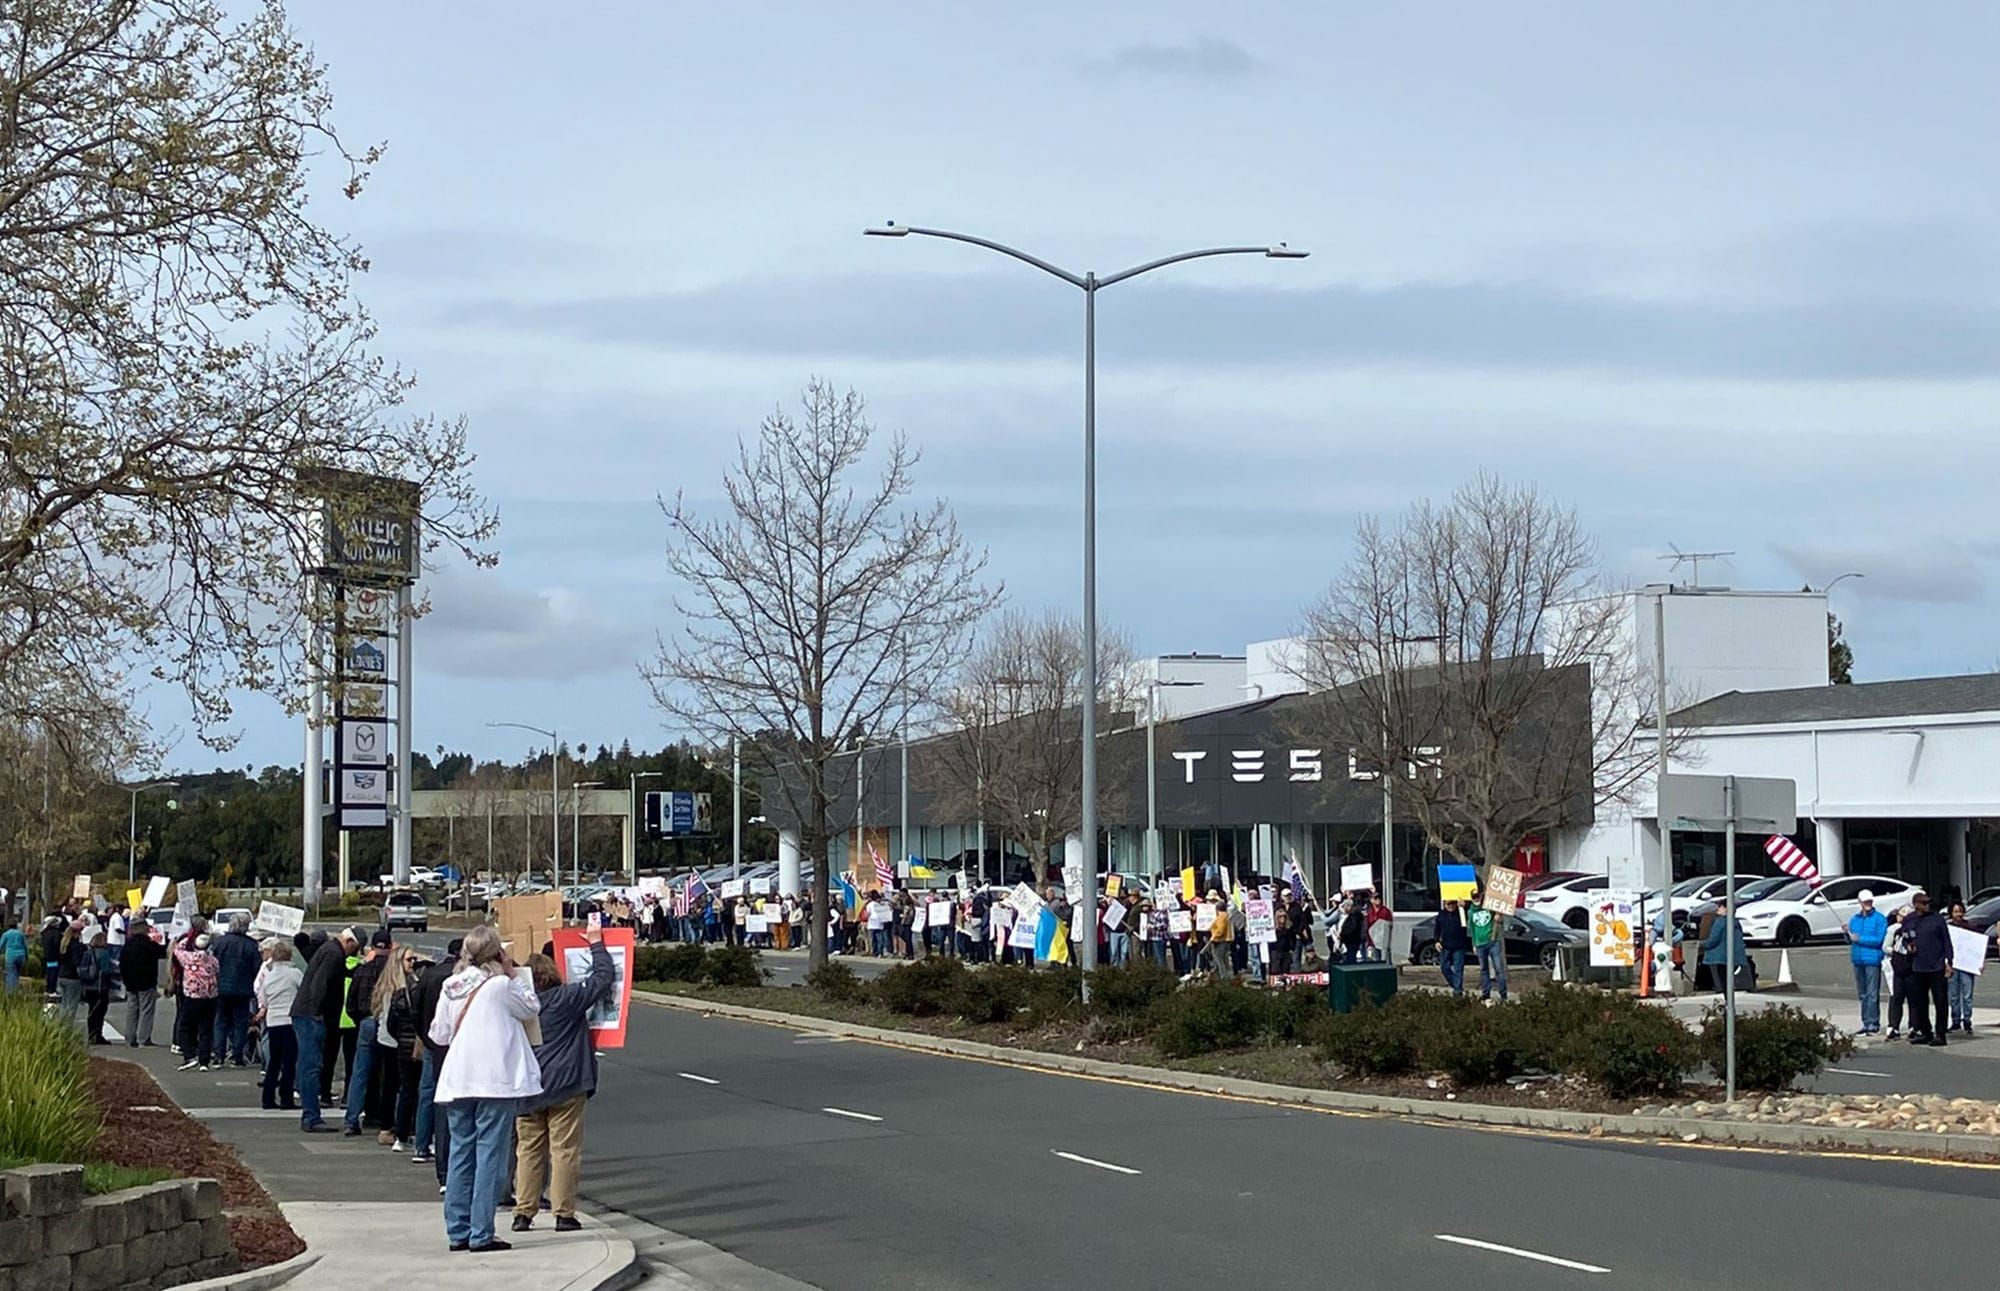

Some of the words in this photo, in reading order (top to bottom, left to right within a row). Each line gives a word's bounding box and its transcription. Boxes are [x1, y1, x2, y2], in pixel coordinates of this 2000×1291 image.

[1172, 746, 1442, 783] TESLA
[1491, 868, 1519, 887] NAZI
[1489, 881, 1519, 899] CARS
[1485, 897, 1513, 914] HERE
